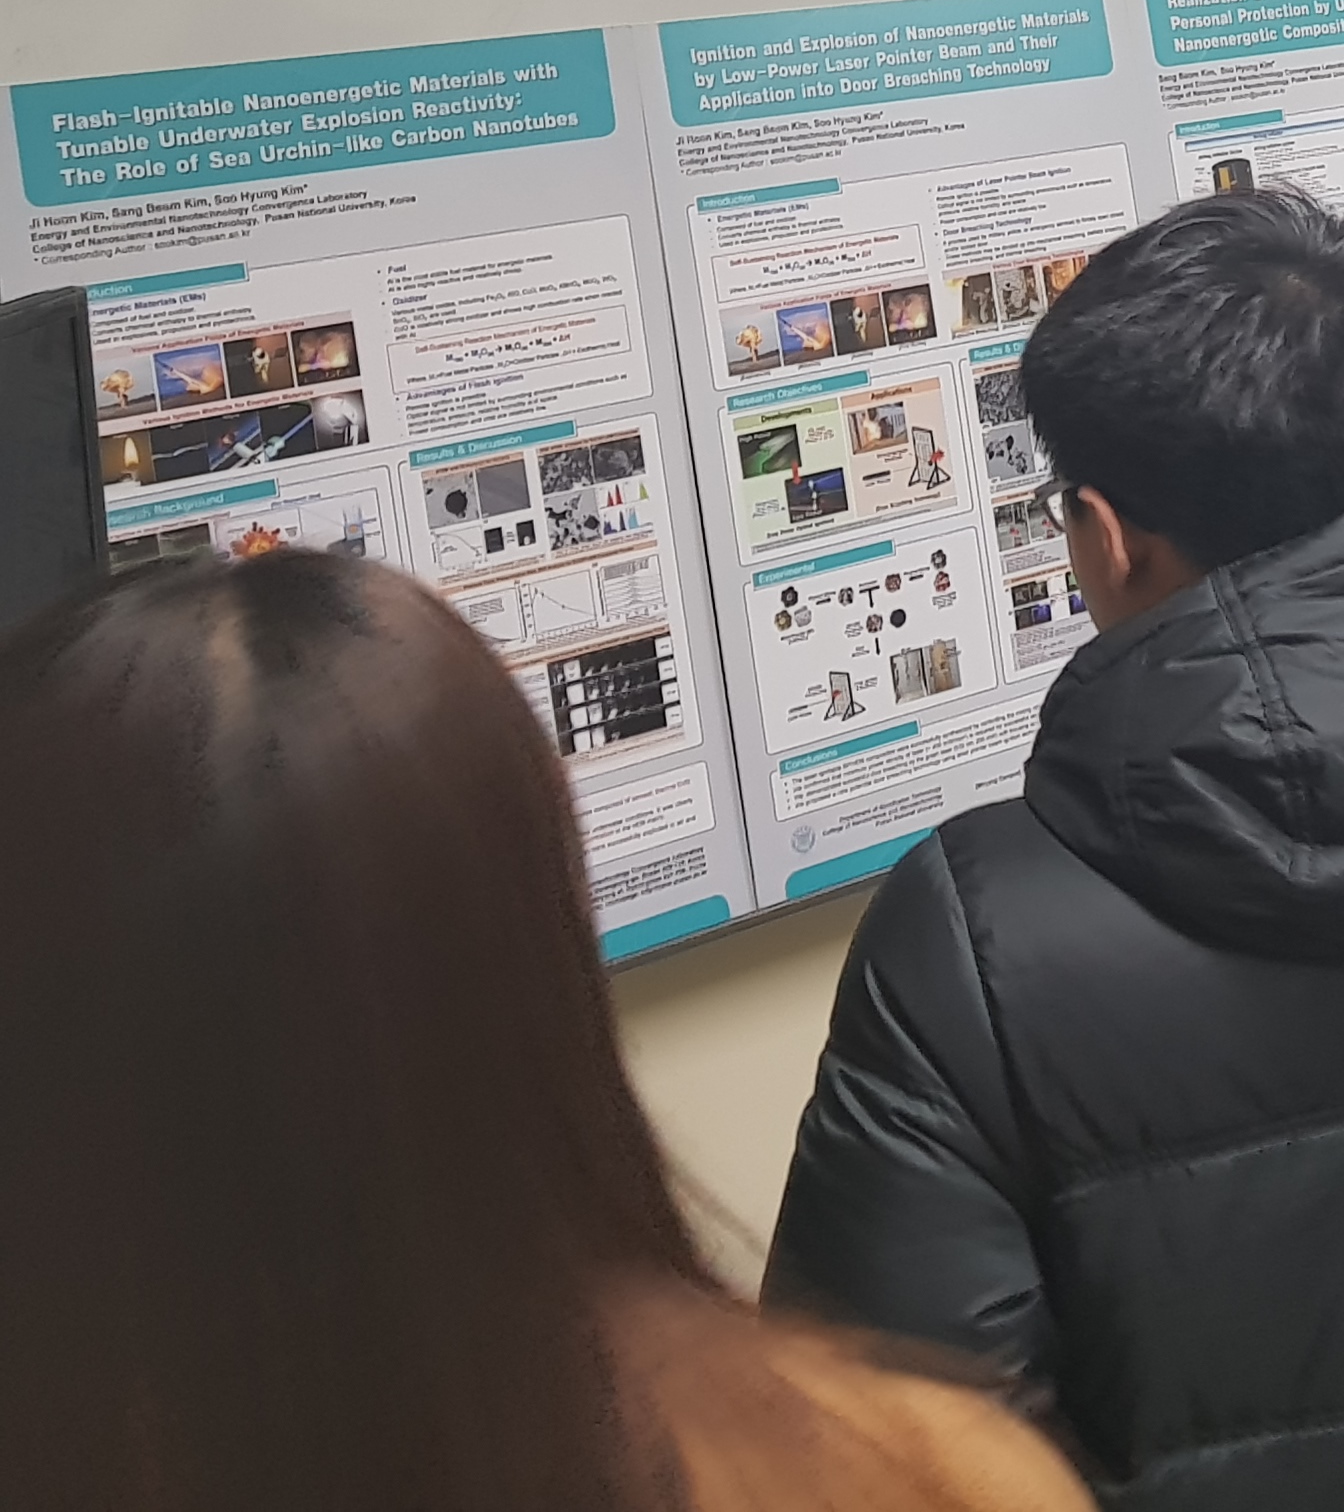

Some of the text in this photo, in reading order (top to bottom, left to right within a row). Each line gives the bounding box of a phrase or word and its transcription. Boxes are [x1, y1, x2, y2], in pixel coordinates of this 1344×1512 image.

[1169, 9, 1232, 30] Personal
[1236, 2, 1309, 22] Protection
[1313, 0, 1330, 15] by
[689, 8, 1089, 65] Ignition and Explosion of Nanoenergetic Materials
[1173, 27, 1277, 51] Nanoenergetic
[693, 32, 1057, 89] by Low-Power Laser Pointer Beam and Their
[52, 62, 557, 131] Flash-Ignitable Nanoenergetic Materials with
[699, 57, 1049, 111] Application into Door Breaching Technology
[55, 92, 521, 158] Tunable Underwater Explosion Reactivity:
[58, 111, 578, 186] The Role of Sea Urchin-like Carbon Nanotubes
[701, 193, 755, 207] Introduction
[732, 383, 822, 406] Research Objectives
[415, 435, 522, 463] Results & Discussion
[784, 749, 838, 770] Conclusions
